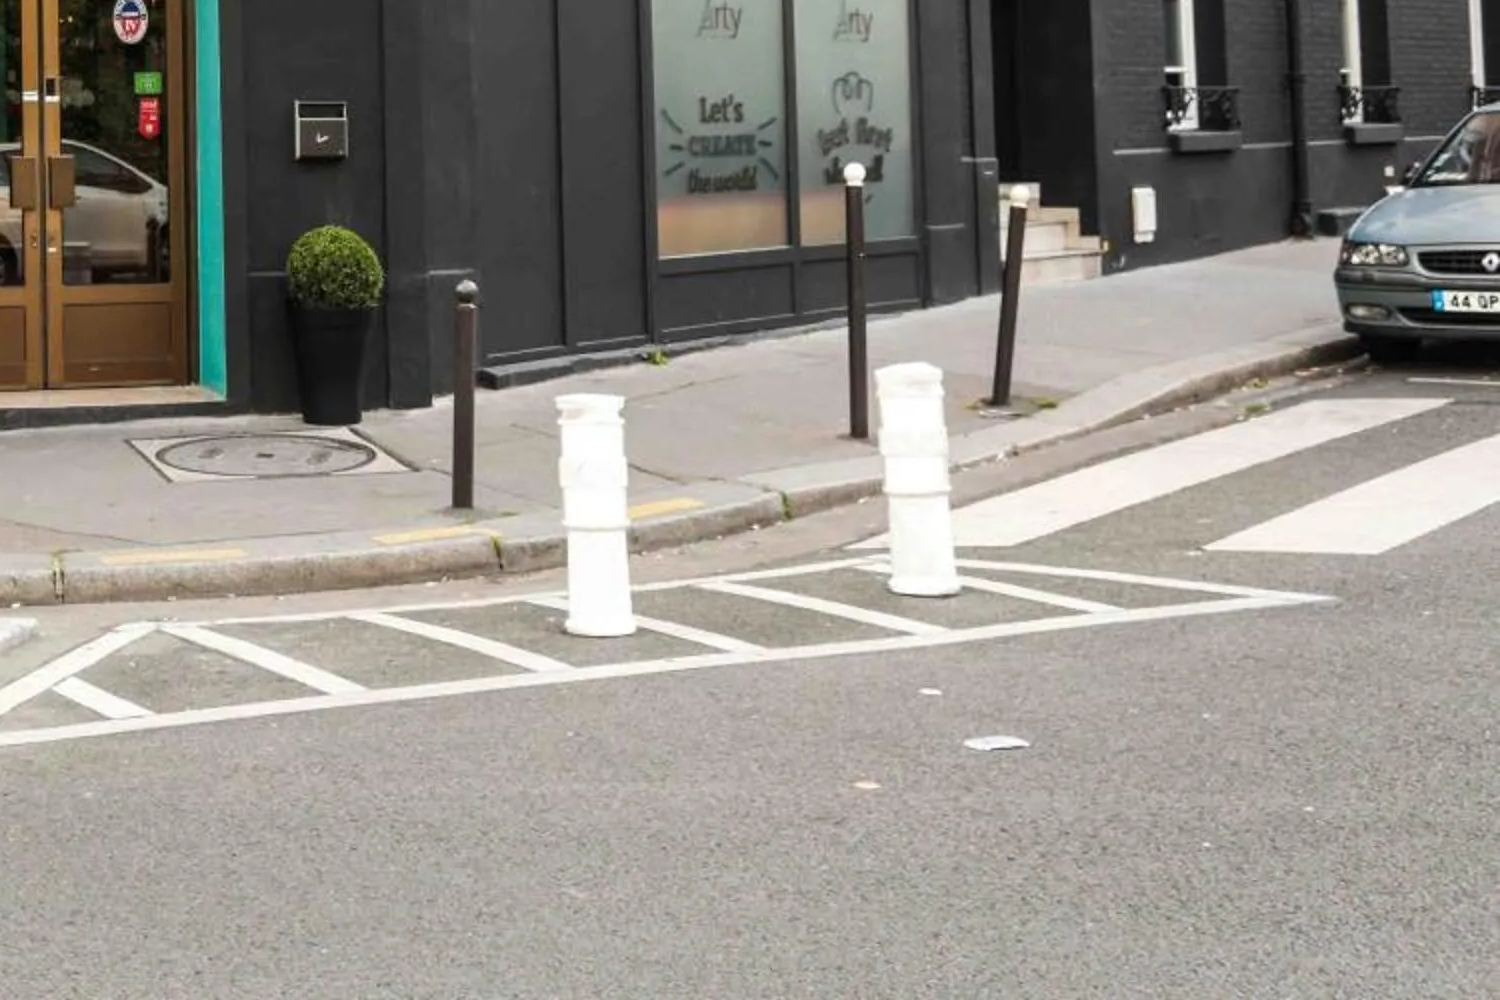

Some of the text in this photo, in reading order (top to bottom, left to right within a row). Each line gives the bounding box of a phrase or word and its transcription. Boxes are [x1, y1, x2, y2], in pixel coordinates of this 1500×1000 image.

[699, 94, 744, 124] Let's
[689, 135, 756, 157] CREATE
[1451, 294, 1471, 308] 44
